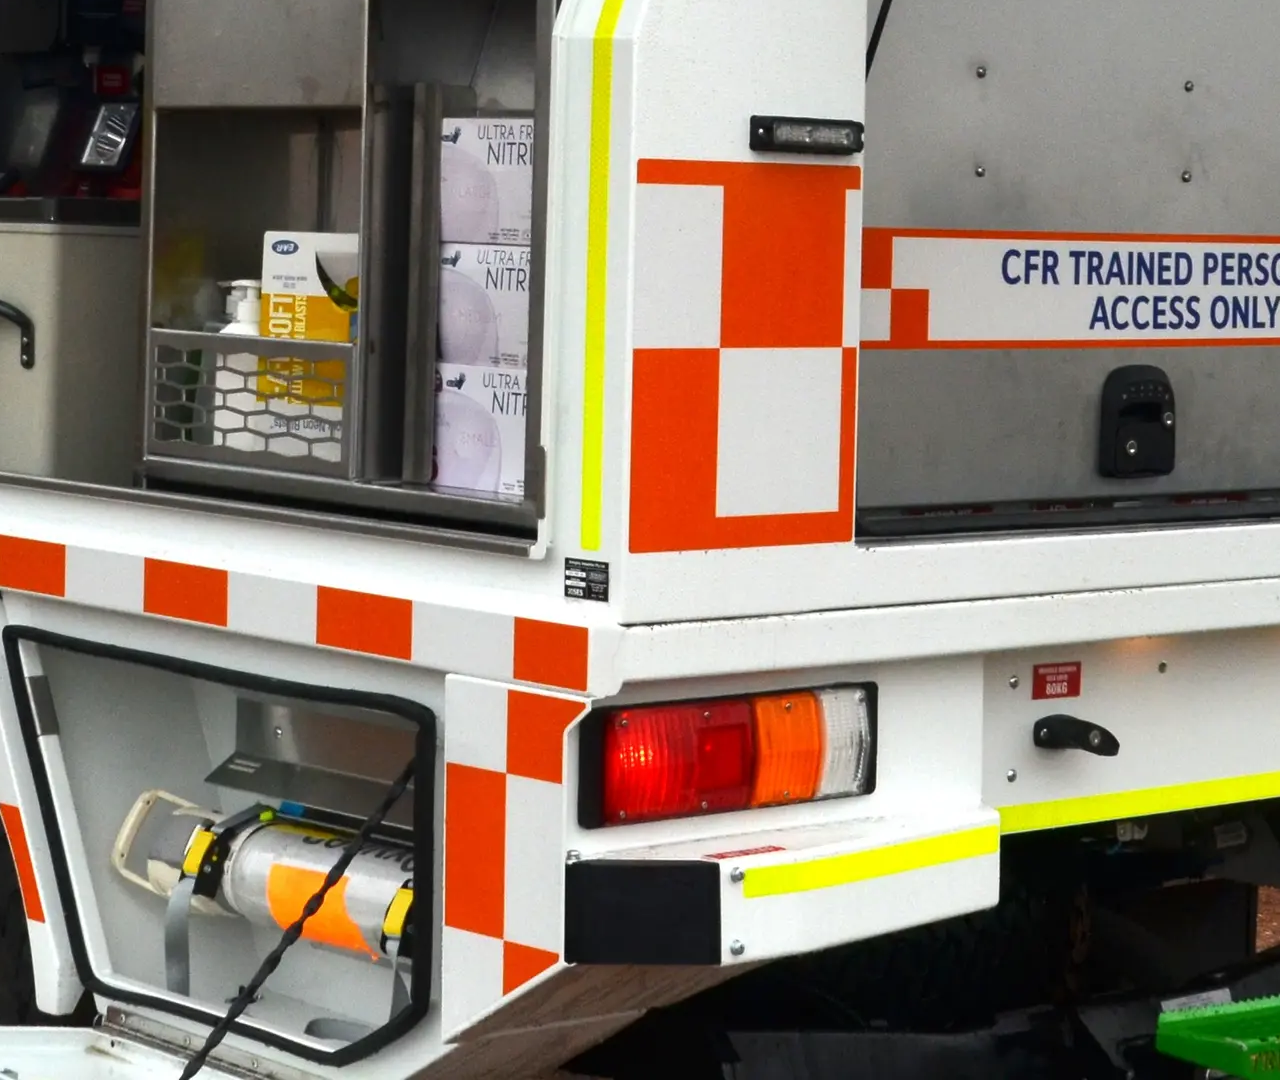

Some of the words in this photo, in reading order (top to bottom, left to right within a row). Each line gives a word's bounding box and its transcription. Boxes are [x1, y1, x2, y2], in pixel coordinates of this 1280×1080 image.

[477, 124, 515, 140] ULTRA
[477, 249, 515, 266] ULTRA
[1001, 248, 1060, 287] CFR
[1070, 250, 1193, 286] TRAINED
[1089, 295, 1200, 330] ACCESS
[483, 373, 520, 390] ULTRA
